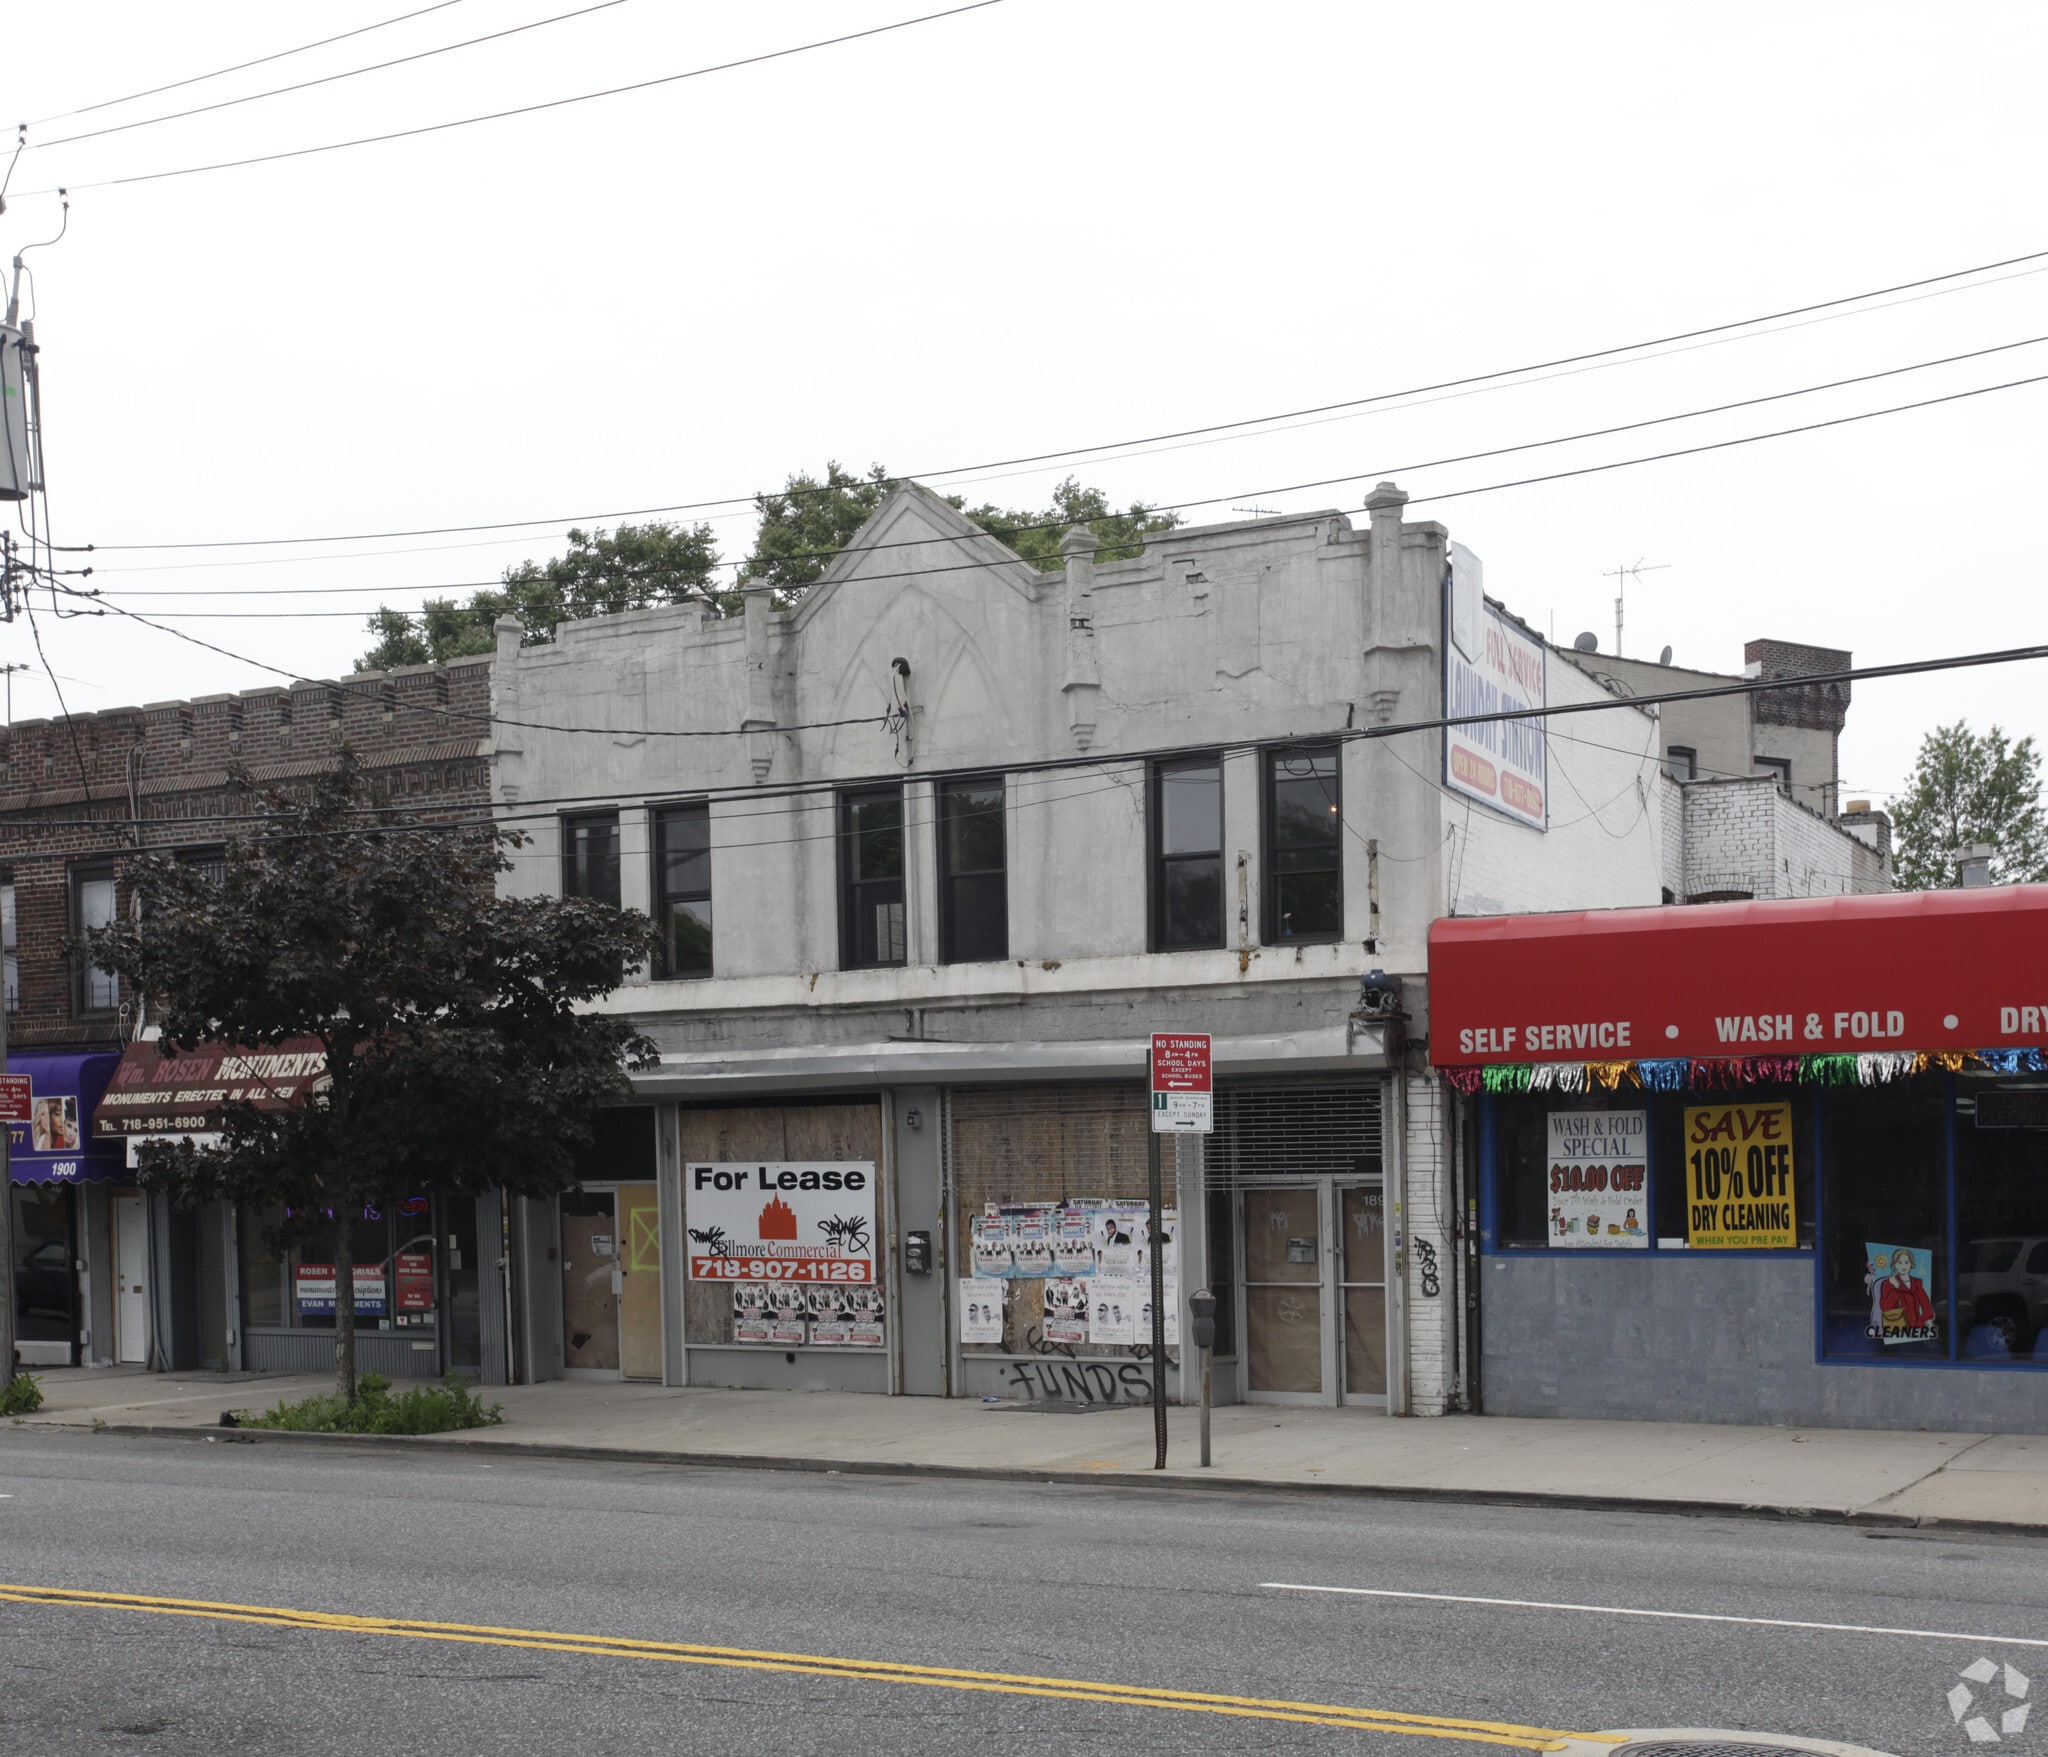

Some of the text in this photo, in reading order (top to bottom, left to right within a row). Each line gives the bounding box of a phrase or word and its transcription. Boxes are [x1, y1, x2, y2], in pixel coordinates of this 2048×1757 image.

[1487, 628, 1542, 697] FULL SERVICE
[1450, 656, 1543, 781] LAUNDRY STATION
[1714, 1010, 1905, 1043] WASH & FOLD
[1156, 1040, 1207, 1049] NO STANDING
[1459, 1021, 1632, 1054] SELF SERVICE
[151, 1058, 214, 1083] ROSEN
[213, 1052, 329, 1080] MONUMENTS
[102, 1091, 172, 1106] MONUMENTS
[229, 1088, 245, 1101] IN
[245, 1087, 268, 1100] ALL
[122, 1116, 206, 1131] 718-951-6900
[1553, 1116, 1643, 1136] WASH & FOLD
[1690, 1108, 1784, 1144] SAVE
[1563, 1137, 1632, 1156] SPECIAL
[52, 1162, 77, 1176] 1900
[694, 1166, 866, 1191] For Lease
[1550, 1163, 1645, 1194] $10.00 OFF
[1690, 1144, 1789, 1201] 10% OFF
[1608, 1195, 1622, 1206] Fold
[1623, 1194, 1643, 1206] Order
[1692, 1202, 1790, 1231] DRY CLEANING
[767, 1241, 842, 1258] Commercial
[1696, 1235, 1789, 1245] WHEN YOU PRE PAY
[299, 1267, 328, 1276] ROSEN
[696, 1260, 866, 1280] 718-907-1126
[302, 1300, 324, 1308] EVAN
[1866, 1325, 1938, 1338] CLEANERS
[1009, 1362, 1154, 1402] FUNDS
